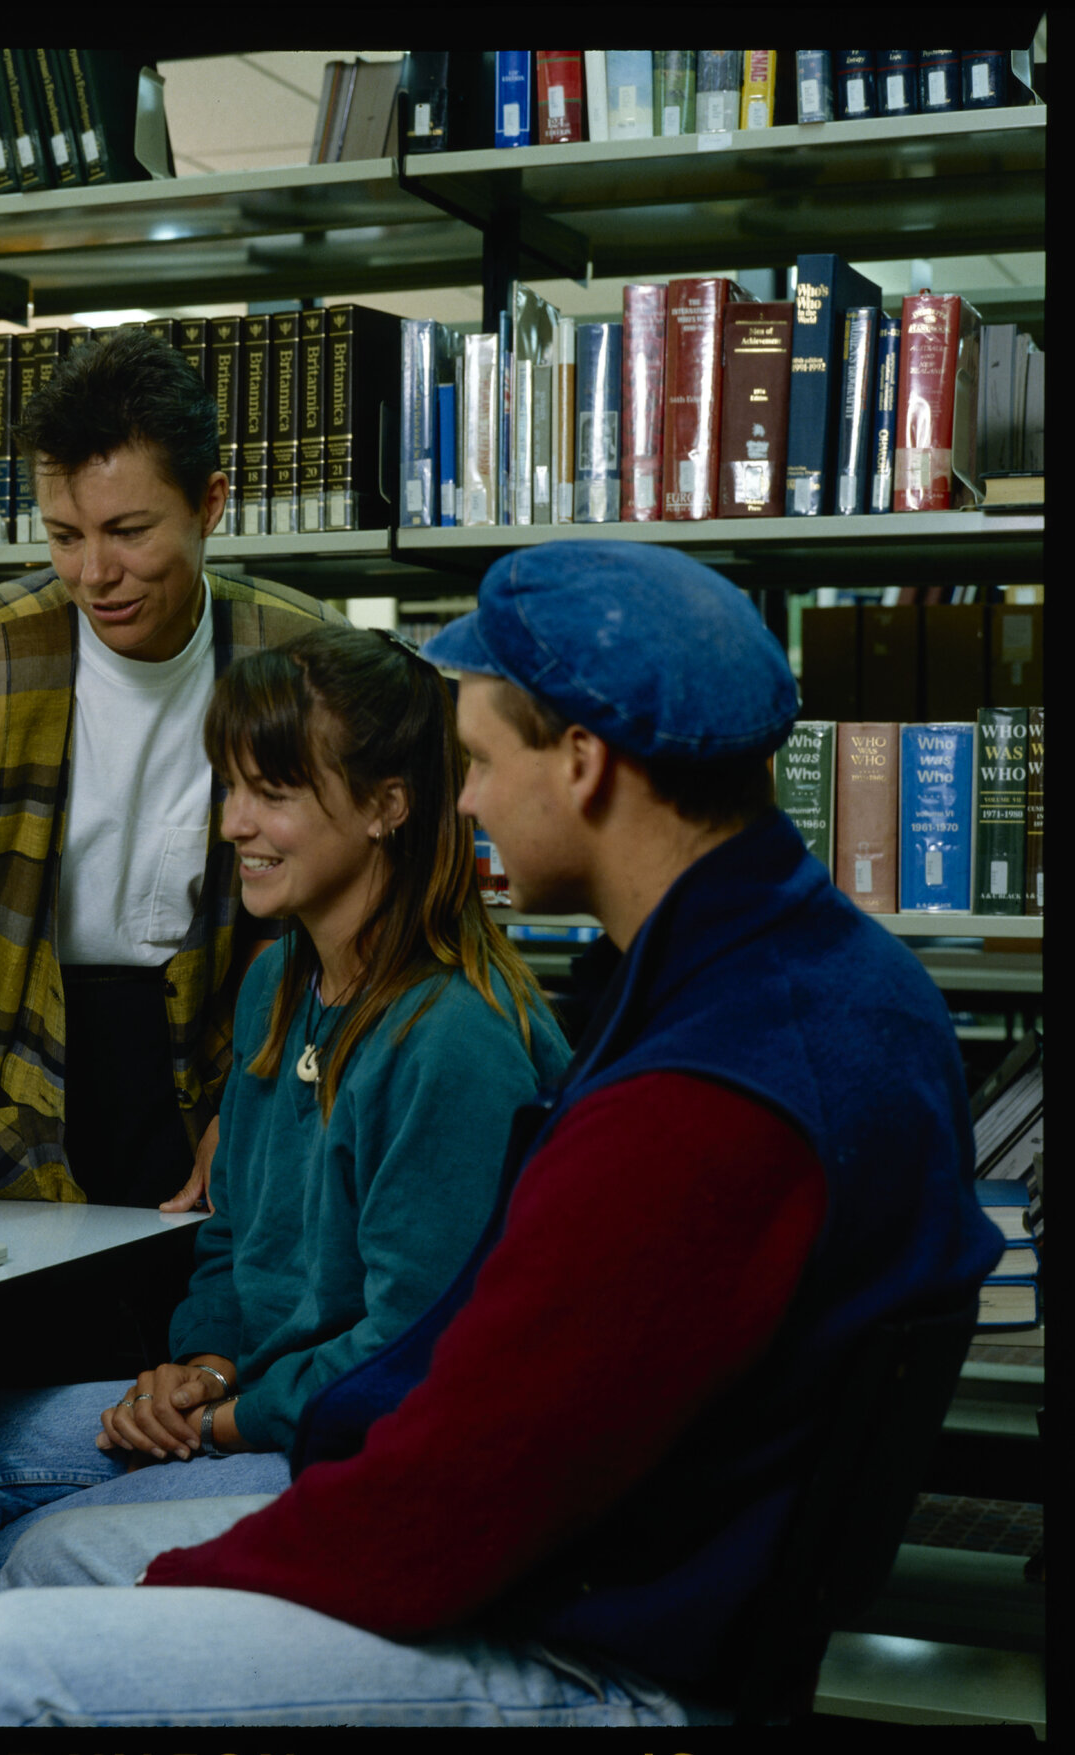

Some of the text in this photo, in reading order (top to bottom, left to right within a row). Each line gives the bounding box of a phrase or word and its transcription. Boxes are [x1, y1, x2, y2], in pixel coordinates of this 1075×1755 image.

[797, 283, 829, 297] Who's
[796, 297, 822, 310] Who
[797, 316, 817, 324] World
[765, 327, 774, 335] of
[741, 337, 782, 345] Achievement
[307, 346, 321, 429] Britannica
[333, 343, 348, 426] Britannica
[217, 354, 232, 435] Britannica
[248, 351, 263, 434] Britannica
[278, 350, 293, 433] Britannica
[278, 470, 290, 481] 19
[305, 466, 317, 478] 20
[332, 465, 343, 476] 21
[247, 471, 259, 483] 18
[666, 493, 711, 504] EUROA
[981, 724, 1027, 738] WHO
[788, 735, 821, 748] Who
[851, 736, 887, 747] WHO
[918, 737, 954, 750] Who
[857, 747, 878, 755] WAS
[985, 745, 1023, 760] WAS
[789, 753, 820, 763] was
[851, 754, 886, 766] WHO
[920, 755, 952, 765] was
[786, 767, 821, 780] Who
[918, 770, 954, 783] Who
[981, 767, 1026, 781] WHO
[982, 810, 1023, 819] 1971-1980
